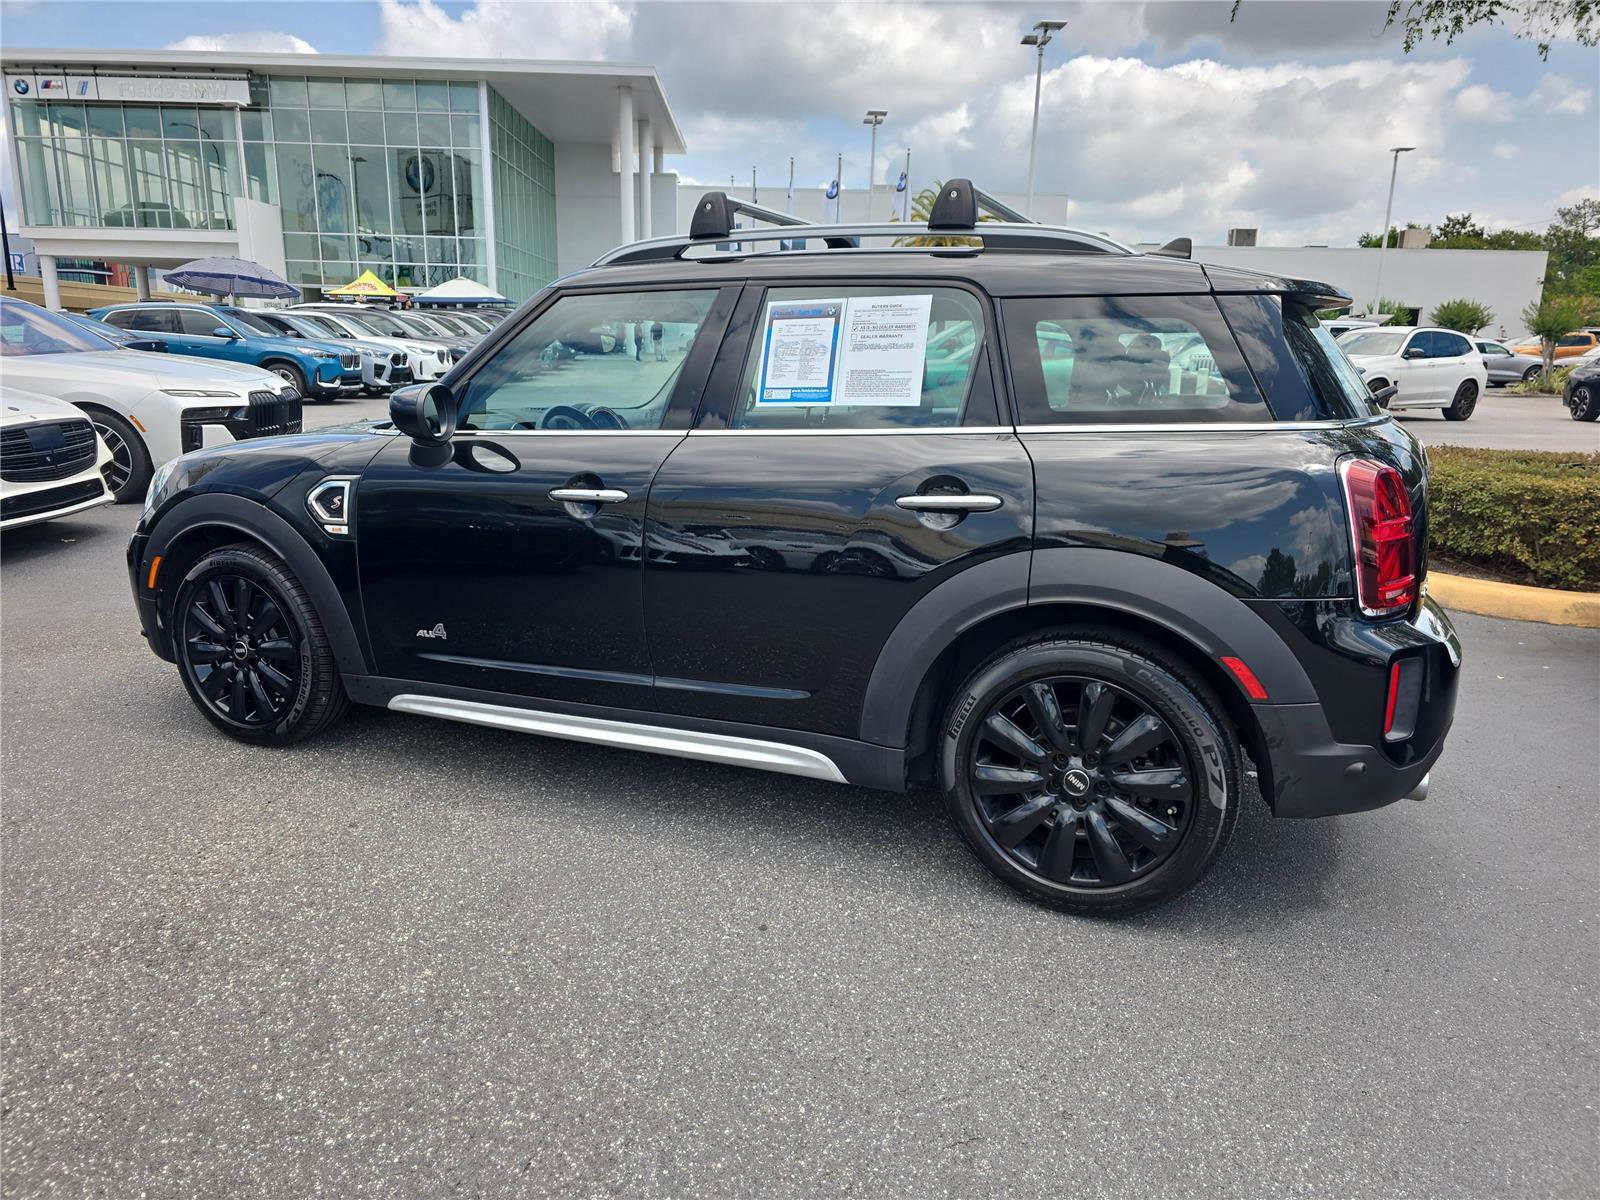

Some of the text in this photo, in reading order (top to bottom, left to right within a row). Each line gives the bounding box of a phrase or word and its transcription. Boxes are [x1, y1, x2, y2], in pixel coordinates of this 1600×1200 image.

[330, 495, 342, 509] S
[946, 695, 977, 741] PIRELLI
[1067, 773, 1085, 791] MINI
[1202, 743, 1226, 794] P7
